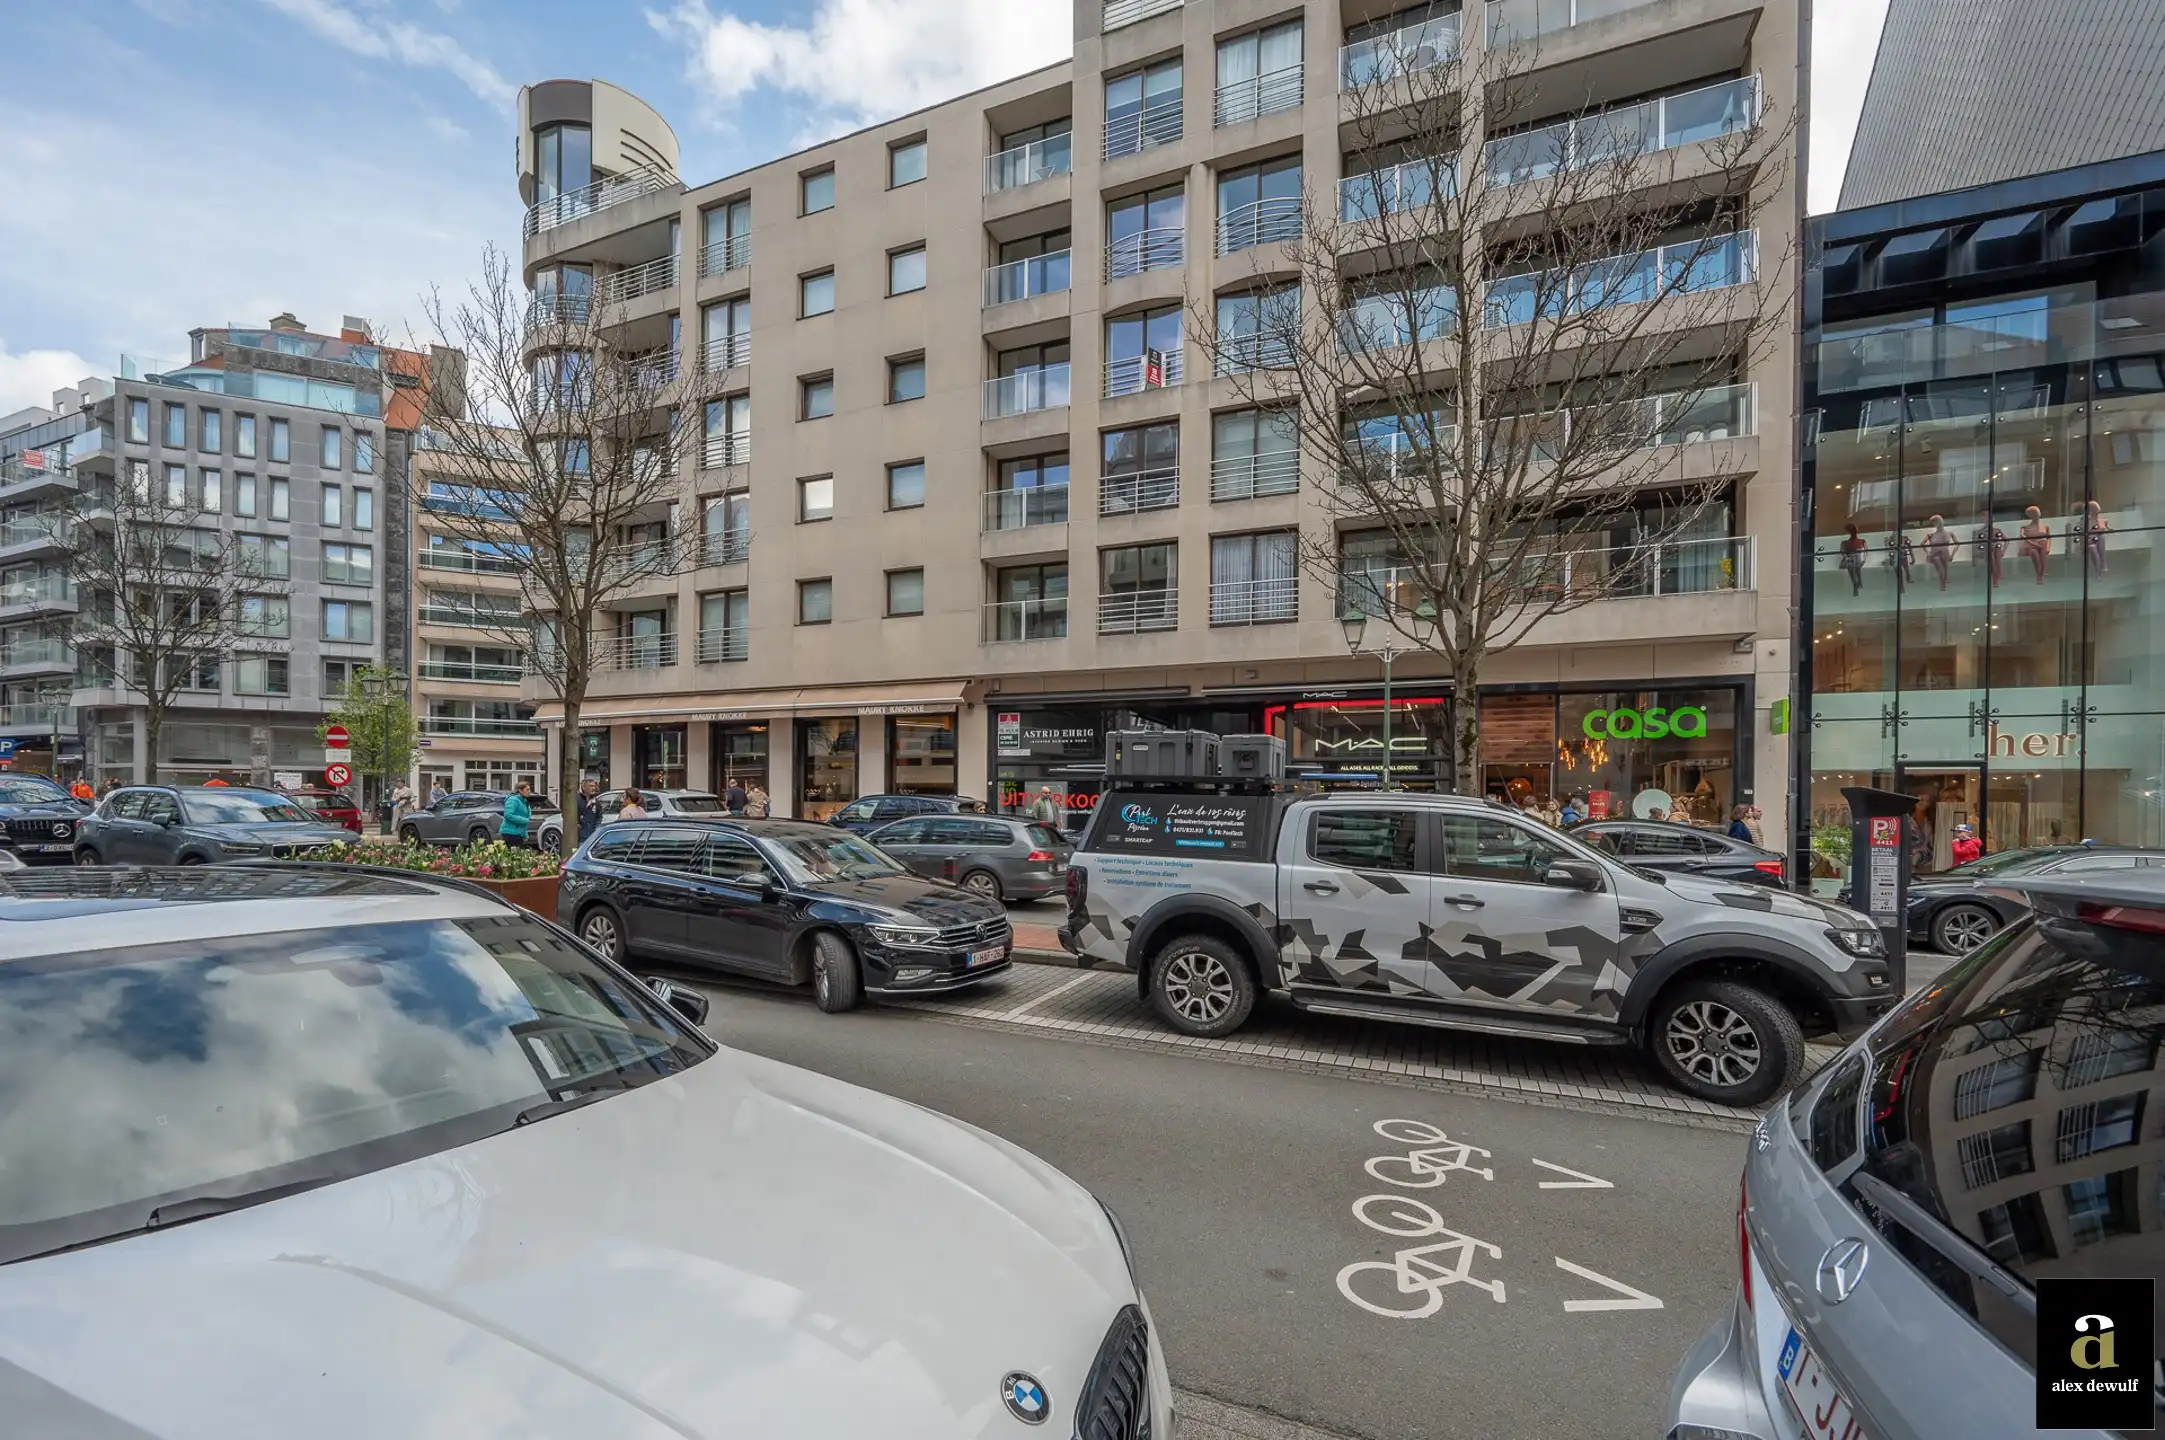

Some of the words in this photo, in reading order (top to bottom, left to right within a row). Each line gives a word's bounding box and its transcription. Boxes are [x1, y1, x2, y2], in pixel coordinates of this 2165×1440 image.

[857, 706, 886, 715] MAURY
[889, 705, 925, 714] KNOKKE
[1582, 706, 1707, 739] casa
[1023, 729, 1060, 739] ASTRID
[1062, 728, 1094, 737] EHRIG
[1195, 804, 1207, 816] de
